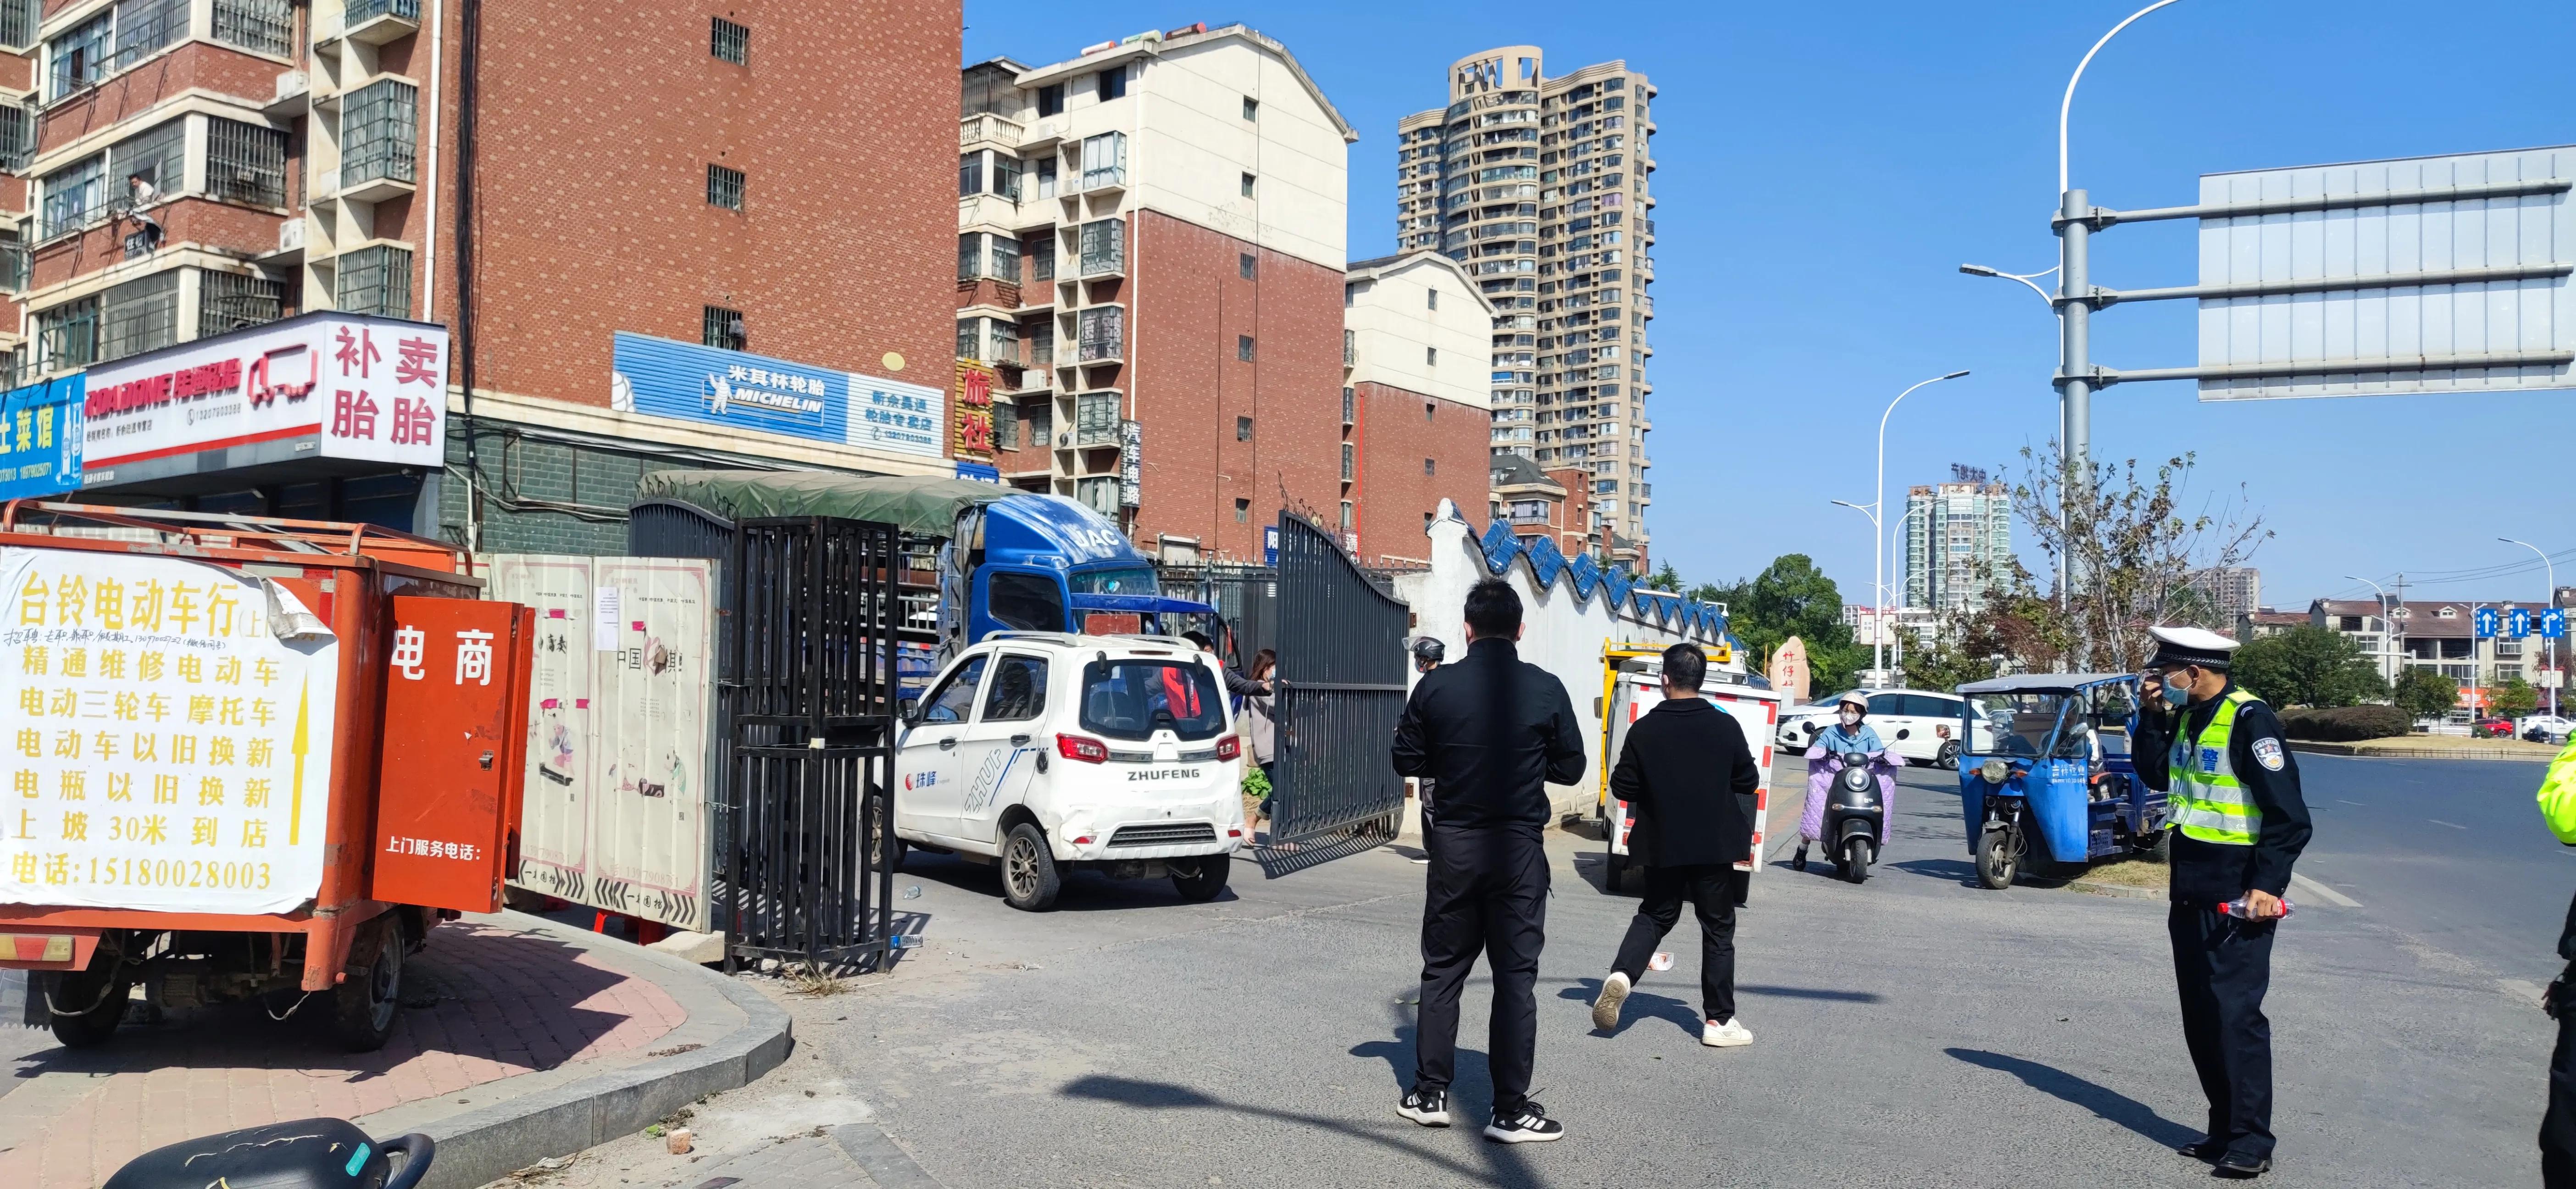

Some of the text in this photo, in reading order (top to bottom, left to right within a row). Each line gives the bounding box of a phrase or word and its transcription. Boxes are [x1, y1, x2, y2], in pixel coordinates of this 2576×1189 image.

[331, 325, 382, 440] 补胎
[390, 335, 439, 447] 卖胎
[728, 365, 825, 397] 米其林轮胎
[734, 387, 822, 412] MICHELIN
[962, 369, 991, 452] 旅社
[1127, 422, 1141, 505] 汽车电路
[1074, 529, 1119, 547] JAC
[19, 571, 239, 637] 台铃电动车行
[22, 645, 280, 687] 精通维修电动车
[391, 625, 493, 686] 电商
[19, 686, 276, 728] 电动三轮车 摩托车
[16, 727, 275, 769] 电动车以旧换新
[2202, 749, 2218, 771] 警
[14, 768, 272, 809] 电瓶以旧换新
[916, 771, 937, 788] 珠峰
[1127, 769, 1200, 781] ZHUFENG
[10, 808, 269, 849] 上坡30米到店
[385, 835, 482, 862] 上门服务电话:
[11, 851, 272, 891] 电话:15180028003
